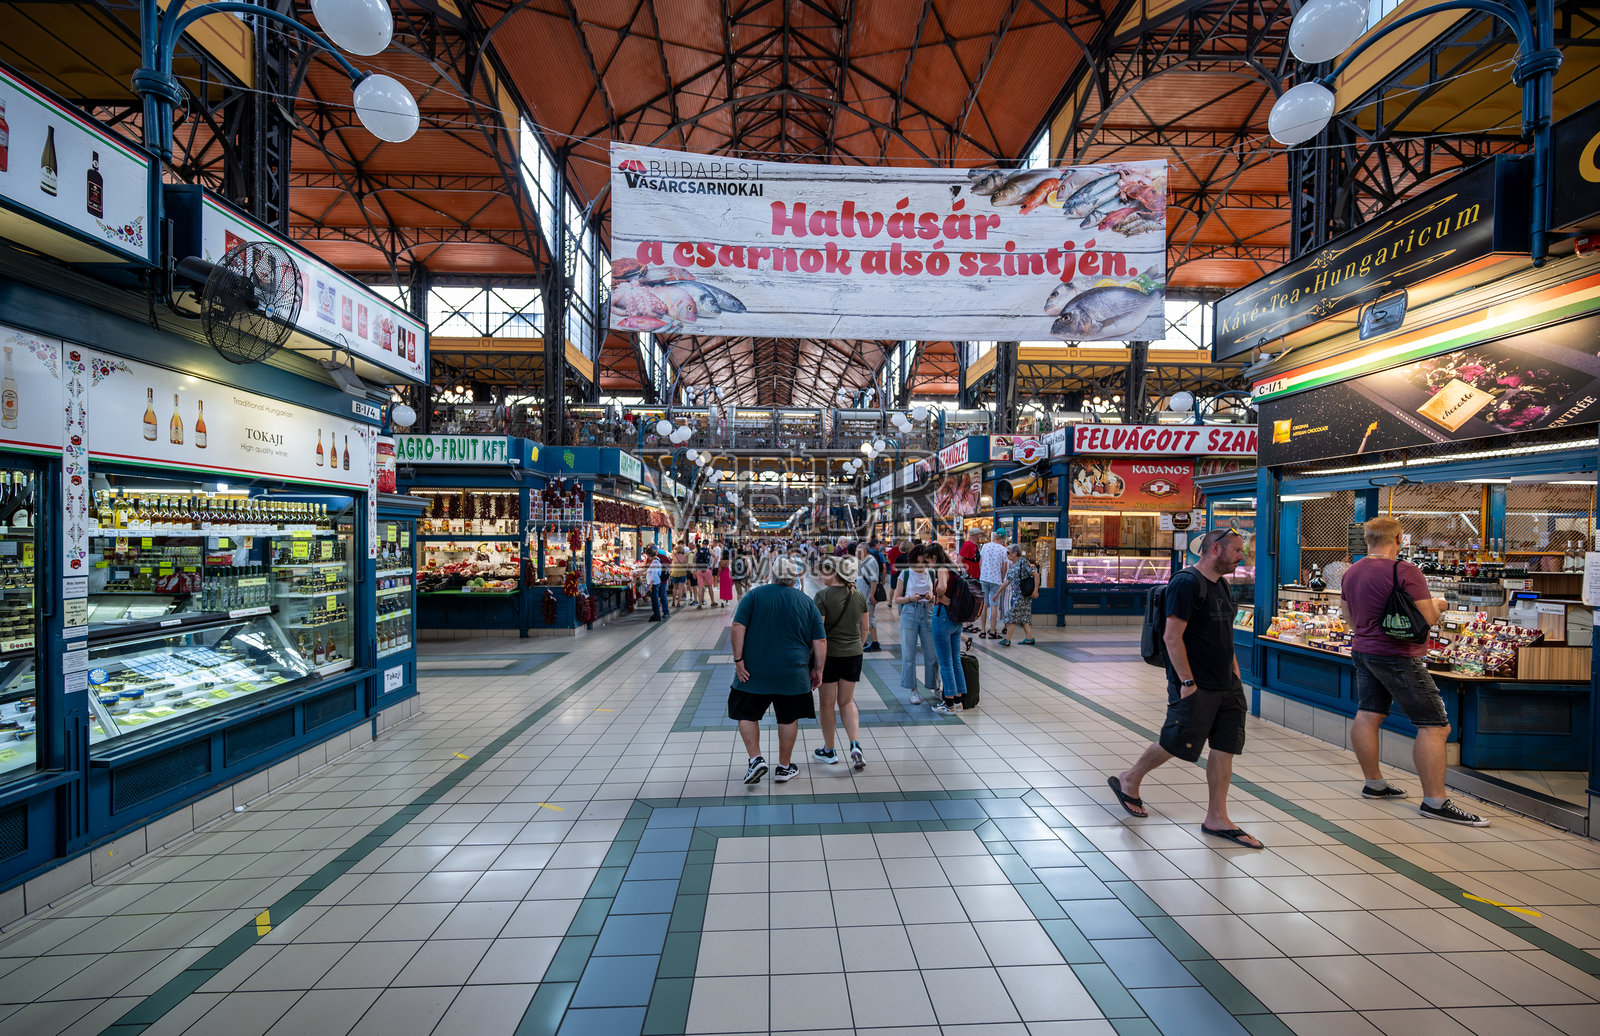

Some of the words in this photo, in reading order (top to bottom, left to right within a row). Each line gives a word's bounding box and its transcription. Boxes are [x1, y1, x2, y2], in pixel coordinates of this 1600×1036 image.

[649, 160, 763, 180] BUDAPEST
[624, 171, 763, 197] VÁSÁRCSARNOKAI
[770, 197, 1001, 240] Halvásár
[636, 241, 665, 266] a
[672, 241, 852, 275] csarnok
[860, 240, 950, 277] alsó
[958, 238, 1138, 283] szintjén.
[1313, 203, 1480, 294] Hungaricum
[233, 397, 265, 411] Traditional
[265, 405, 294, 419] Hungarian
[245, 427, 283, 447] TOKAJI
[396, 437, 478, 460] AGRO-FRUIT
[482, 440, 507, 461] KFT.
[1076, 426, 1200, 451] FELVÁGOTT
[240, 443, 255, 453] High
[255, 446, 274, 456] quality
[1132, 465, 1190, 474] KABANOS
